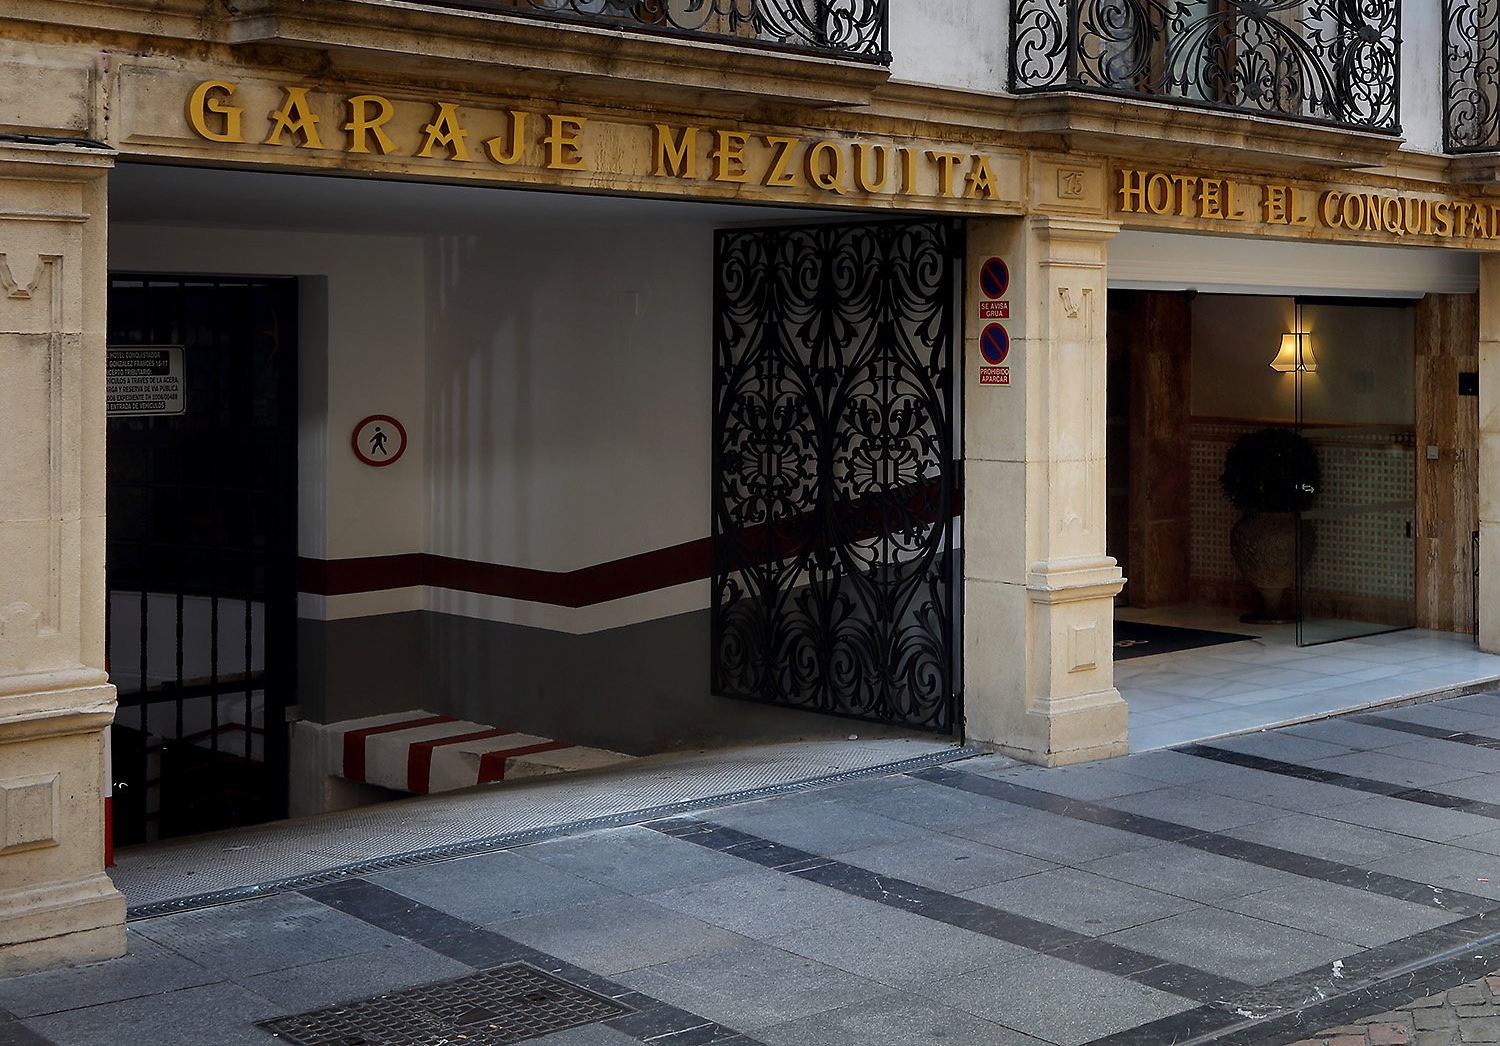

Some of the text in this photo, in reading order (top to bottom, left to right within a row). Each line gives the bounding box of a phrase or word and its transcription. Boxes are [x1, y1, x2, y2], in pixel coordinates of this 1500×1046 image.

[187, 78, 1001, 200] GARAJE MEZQUITA
[1062, 172, 1084, 196] 15
[1117, 167, 1246, 223] HOTEL
[1262, 185, 1310, 226] EL
